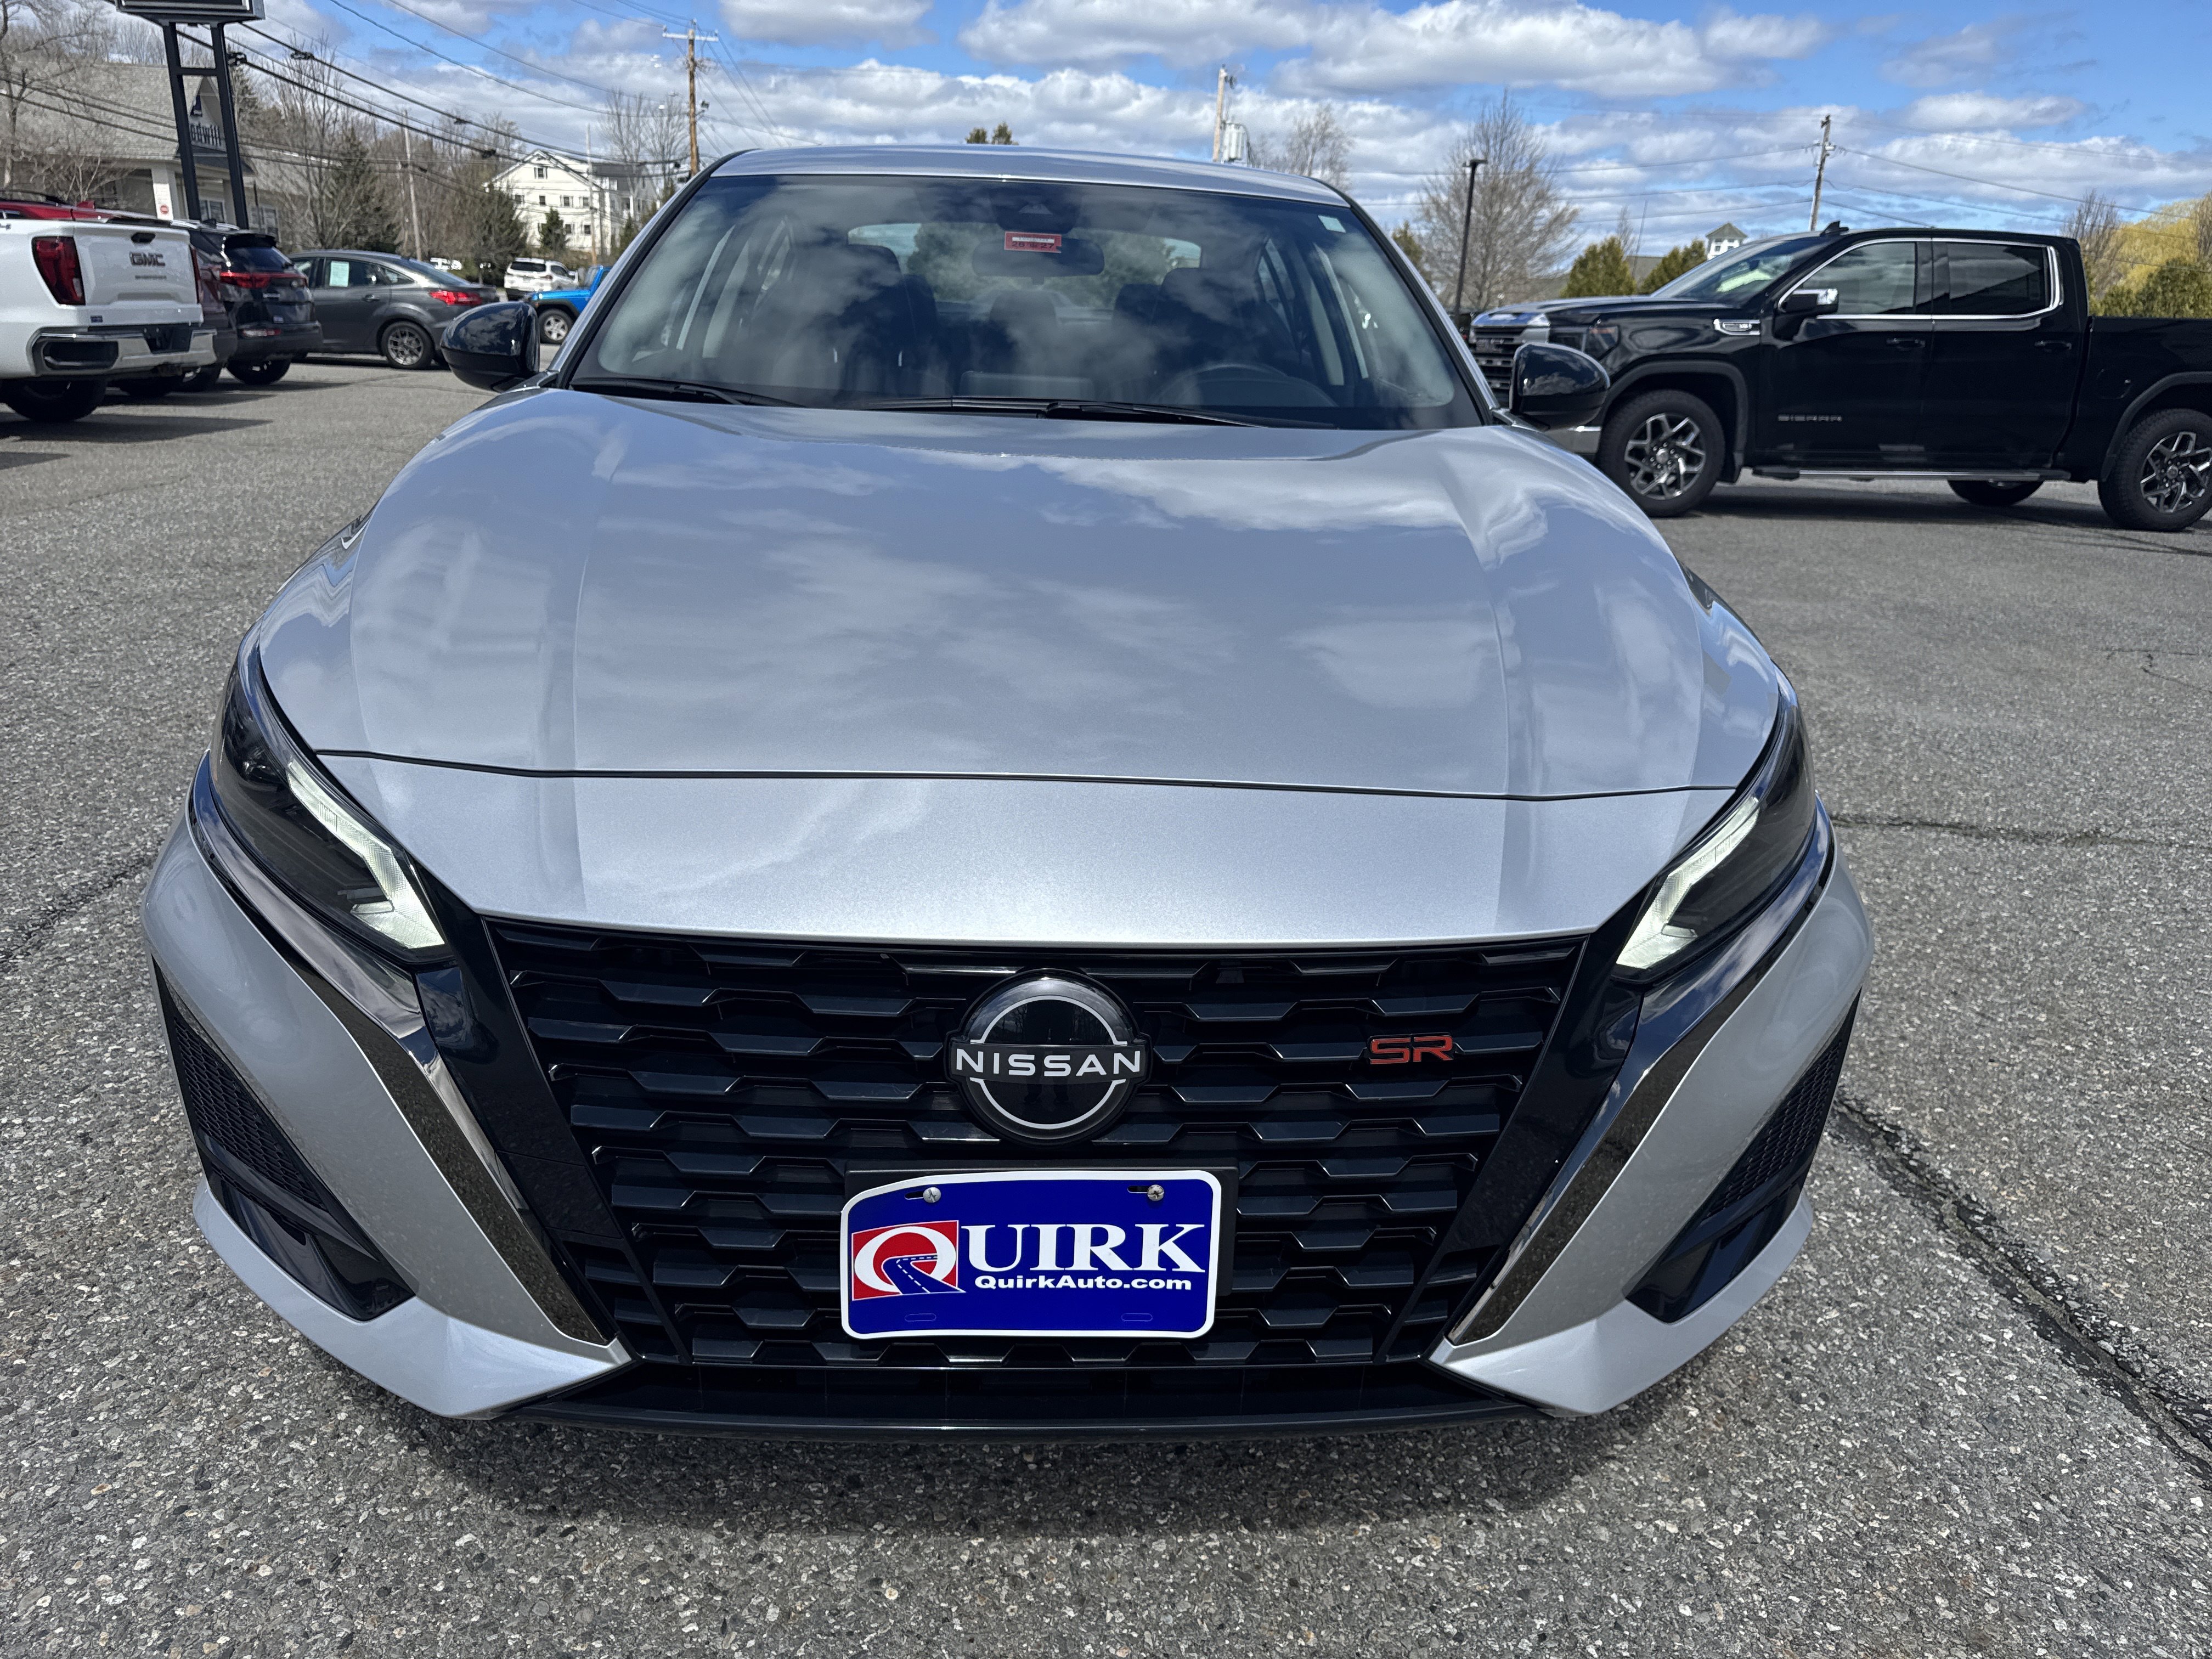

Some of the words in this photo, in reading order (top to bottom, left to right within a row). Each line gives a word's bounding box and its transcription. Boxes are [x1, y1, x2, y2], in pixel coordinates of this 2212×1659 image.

[131, 252, 166, 267] GMC
[956, 1048, 1141, 1076] NISSAN
[1370, 1035, 1454, 1065] SR
[854, 1223, 1205, 1295] QUIRK
[974, 1275, 1192, 1290] QuirkAuto.com
